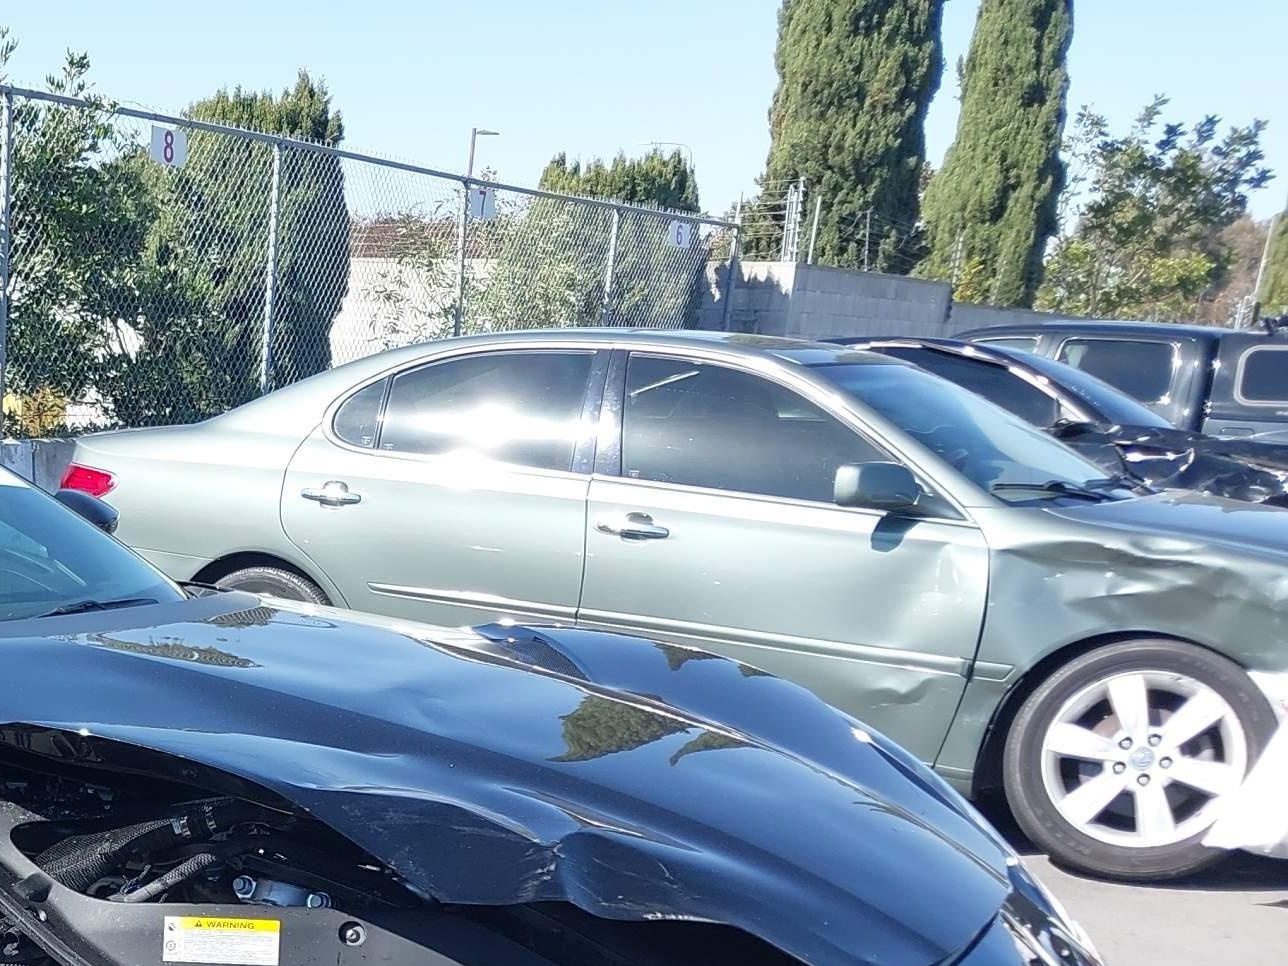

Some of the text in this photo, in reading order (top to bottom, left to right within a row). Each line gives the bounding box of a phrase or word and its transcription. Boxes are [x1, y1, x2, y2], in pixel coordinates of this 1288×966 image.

[163, 130, 174, 163] 8
[479, 190, 487, 216] 7
[676, 224, 684, 246] 6
[206, 920, 255, 930] WARNING
